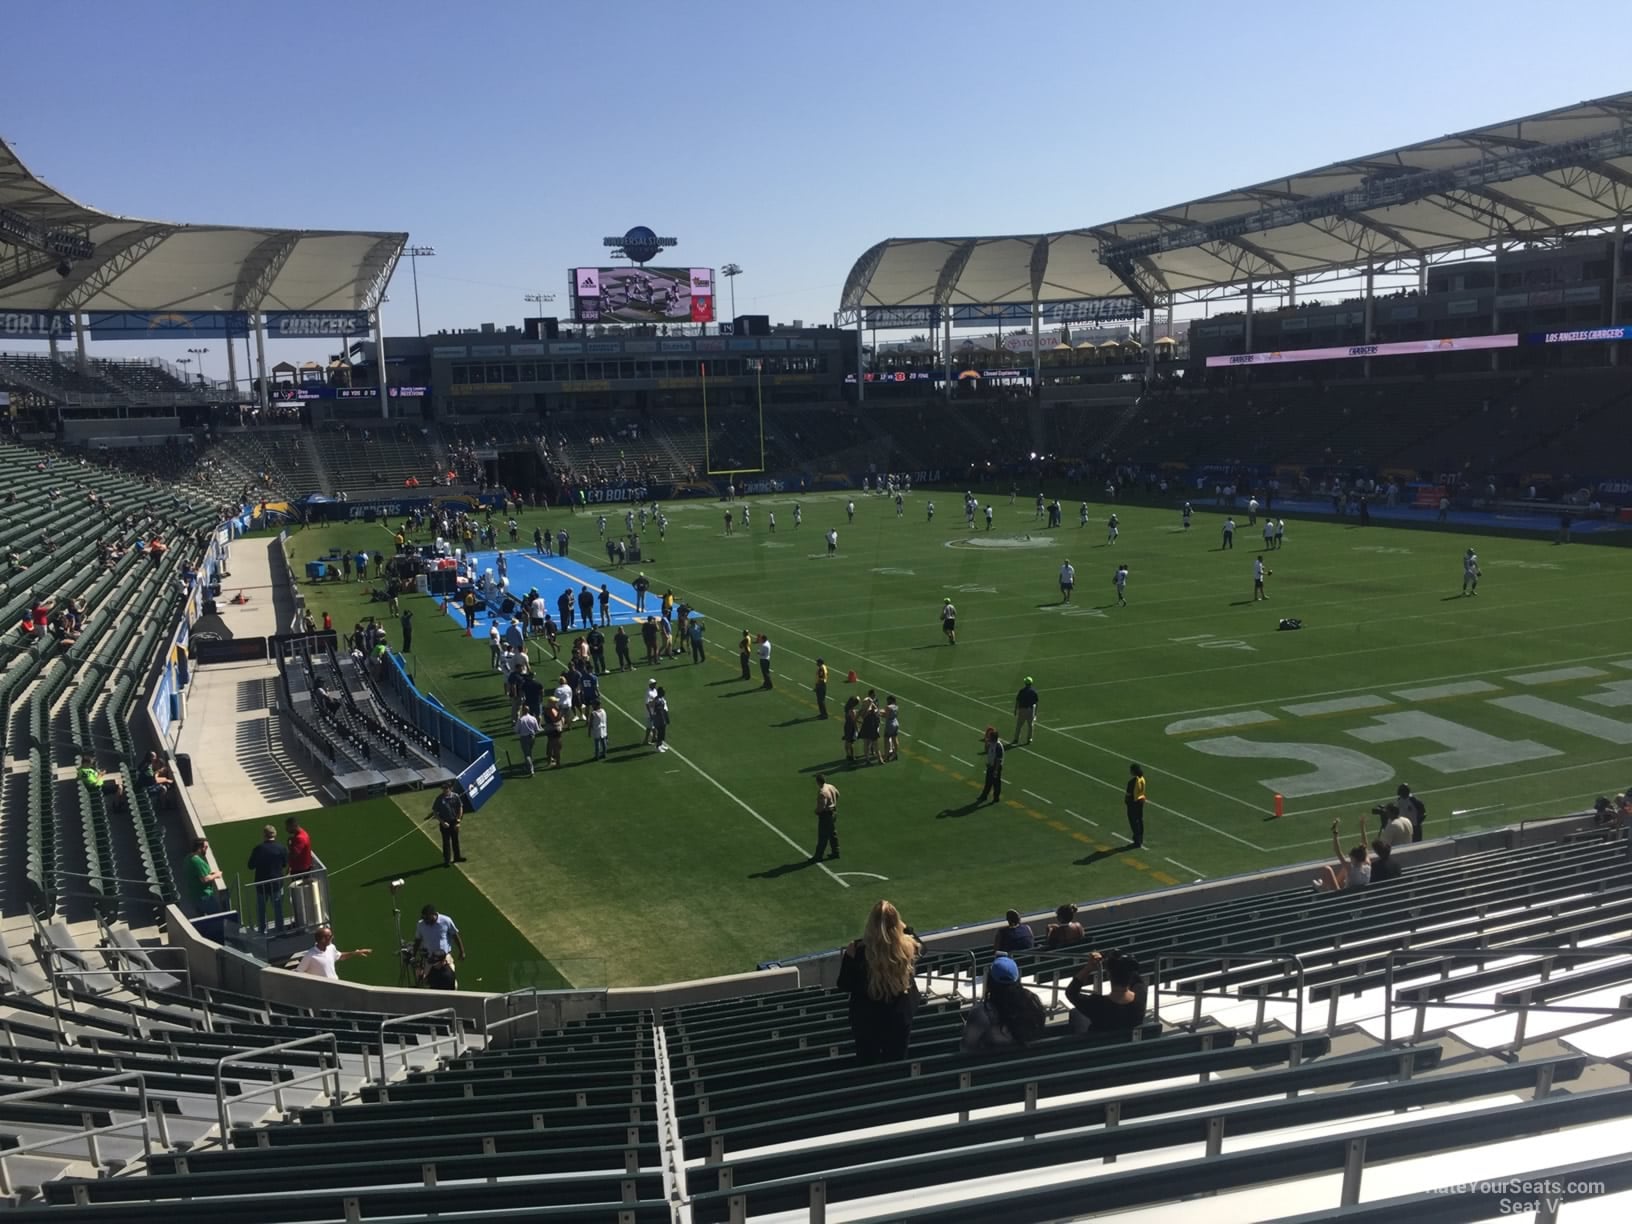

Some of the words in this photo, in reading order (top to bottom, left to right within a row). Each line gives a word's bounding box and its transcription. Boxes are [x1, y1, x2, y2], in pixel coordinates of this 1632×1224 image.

[39, 314, 63, 335] LA
[280, 318, 357, 334] CHARGERS
[1021, 337, 1058, 347] TOOTA
[1545, 333, 1559, 343] LOS
[1558, 331, 1588, 342] ANGELES
[1588, 328, 1625, 340] CHARGERS
[1349, 346, 1378, 356] CHARGERS
